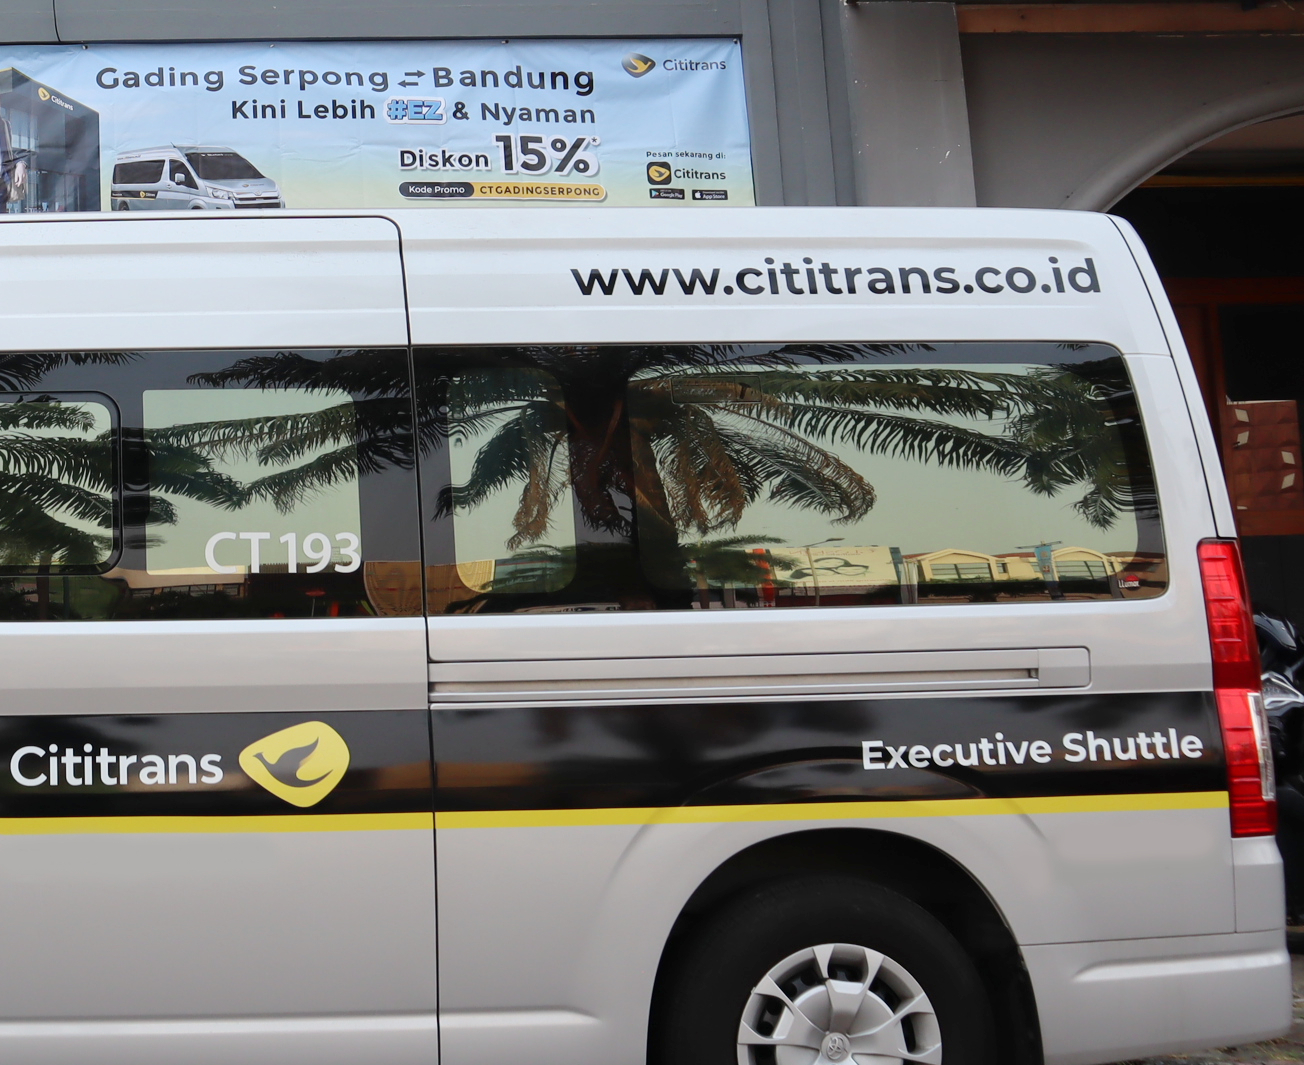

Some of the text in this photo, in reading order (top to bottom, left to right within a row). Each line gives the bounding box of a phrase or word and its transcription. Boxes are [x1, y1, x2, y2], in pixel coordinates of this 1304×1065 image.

[663, 59, 727, 71] Cititrans
[96, 65, 594, 96] Gading Serpong Bandung
[51, 95, 74, 111] Cititrans
[232, 99, 596, 126] Kini Lebih #EZ & Nyaman
[399, 149, 490, 168] Diskon
[676, 151, 713, 160] sekarang
[674, 168, 727, 180] Cititrans
[409, 185, 465, 194] Kode Promo
[480, 185, 600, 196] CTGADINGSERPONG
[571, 257, 1101, 296] www.cititrans.co.id
[205, 531, 362, 574] CT 193
[861, 728, 1203, 770] Executive Shuttle
[10, 743, 224, 787] Cititrans
